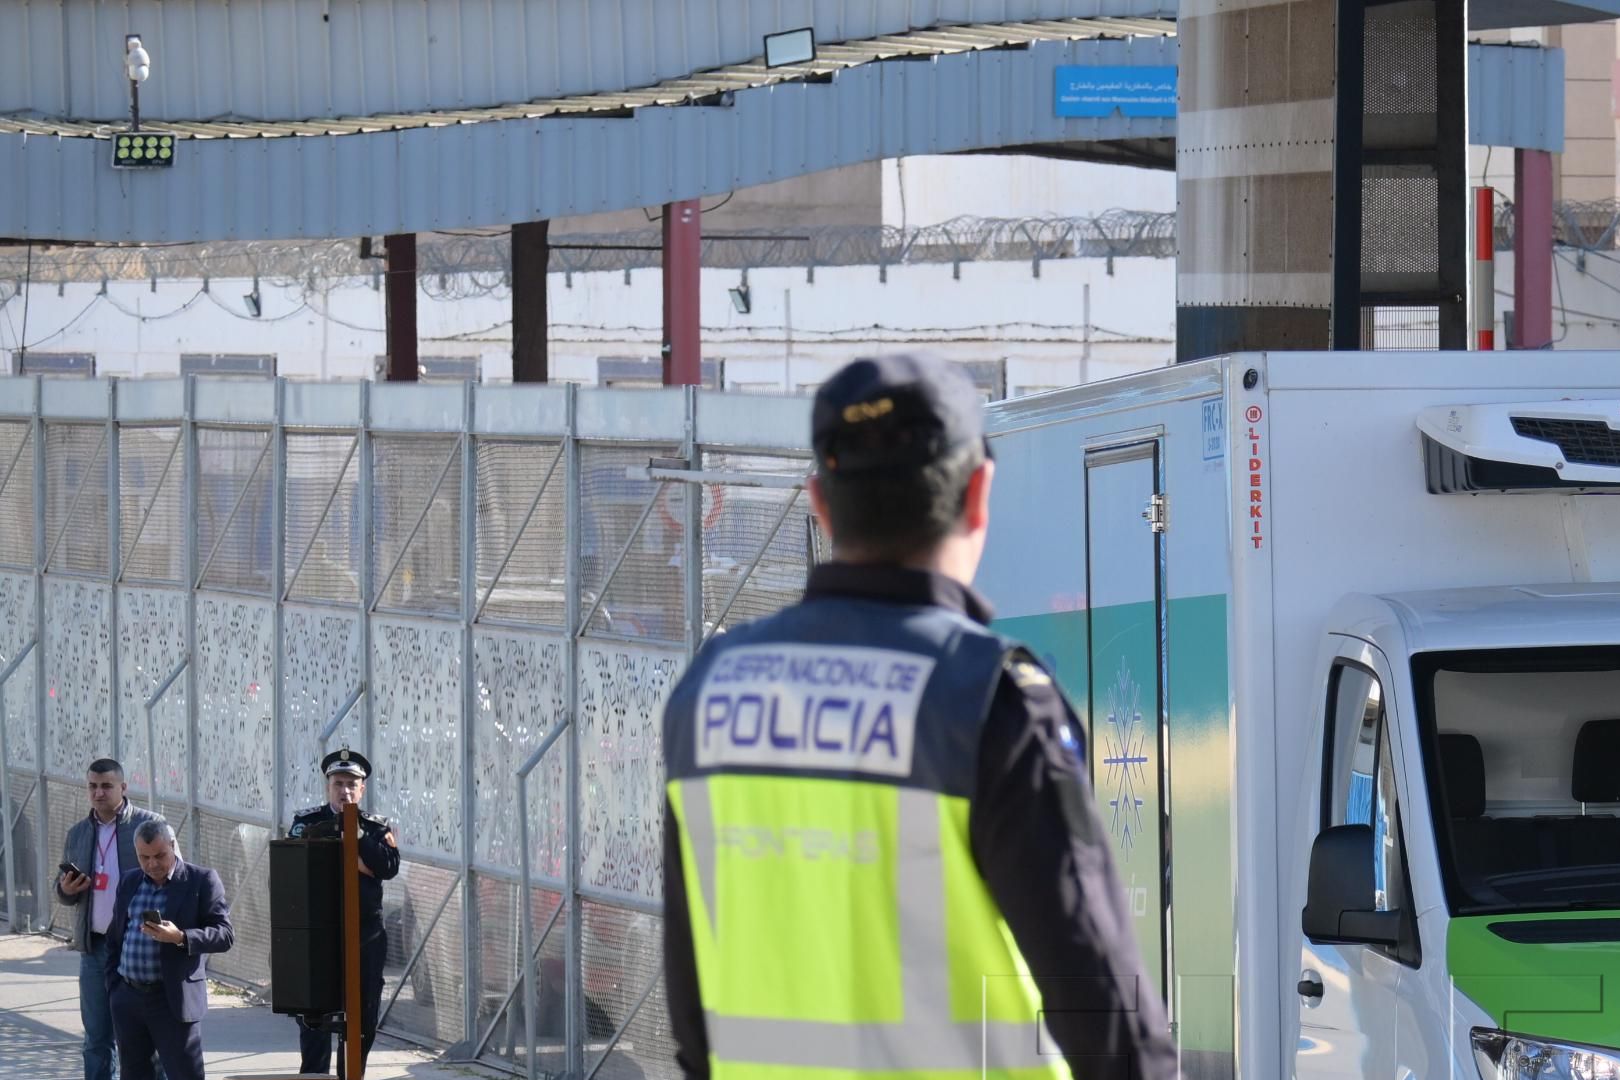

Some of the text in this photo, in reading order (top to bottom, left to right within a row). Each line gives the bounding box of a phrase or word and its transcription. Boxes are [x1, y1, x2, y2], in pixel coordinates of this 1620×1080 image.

[1248, 427, 1263, 550] LIDERKIT
[788, 655, 879, 690] NACIONAL
[884, 661, 921, 693] DE
[704, 692, 898, 759] POLICIA
